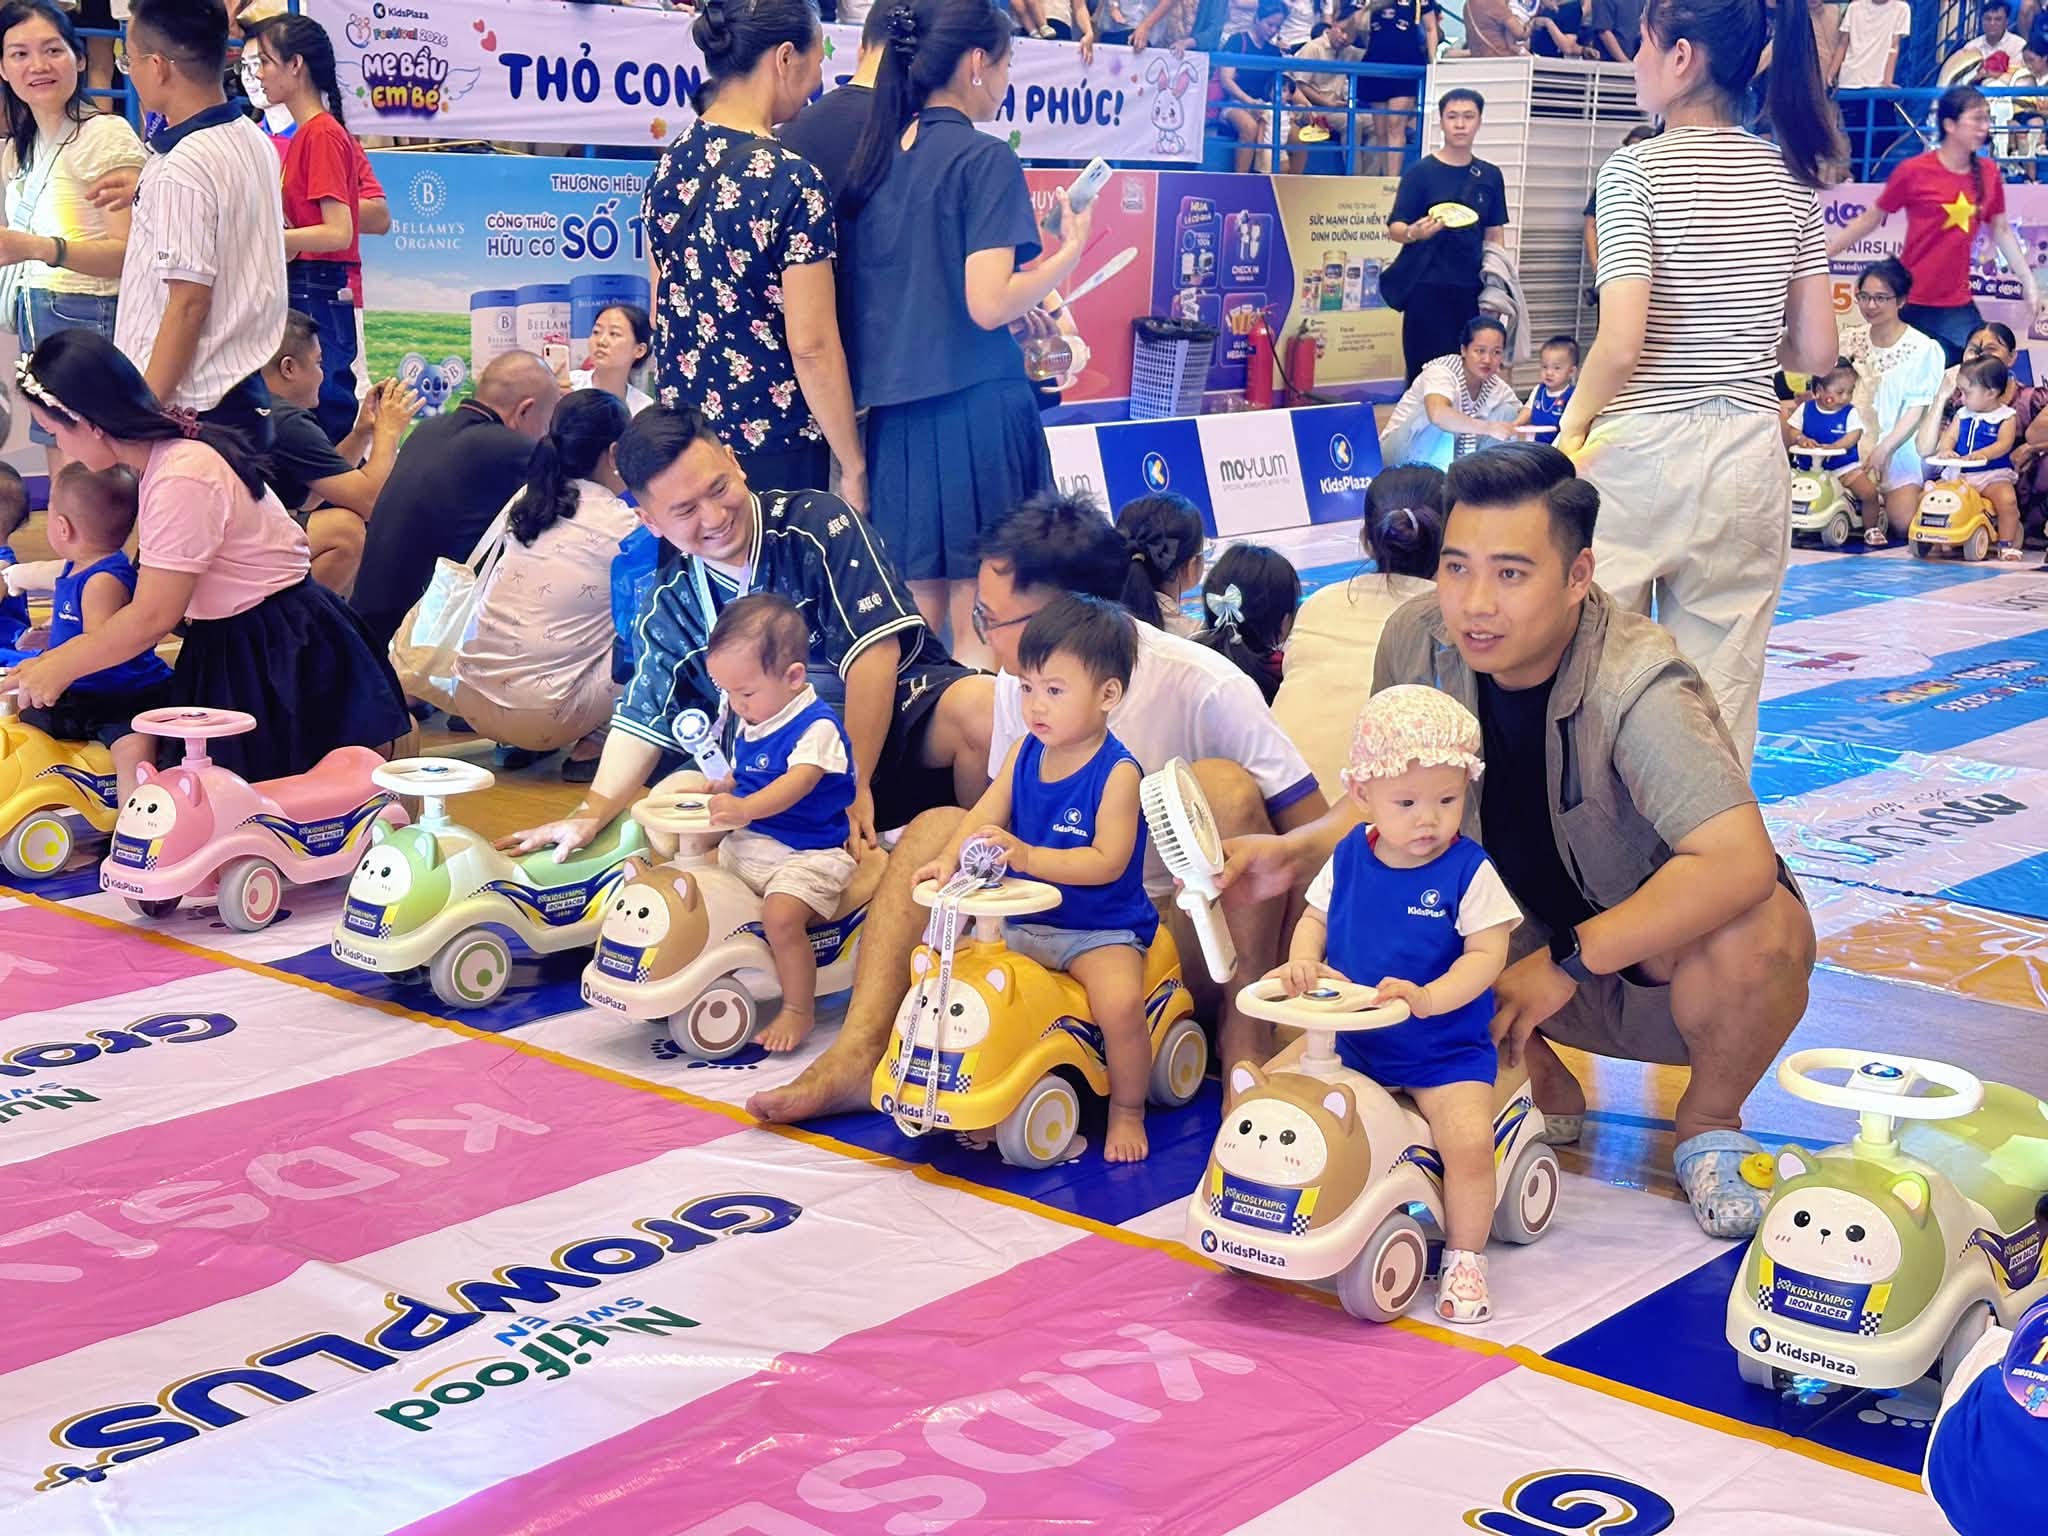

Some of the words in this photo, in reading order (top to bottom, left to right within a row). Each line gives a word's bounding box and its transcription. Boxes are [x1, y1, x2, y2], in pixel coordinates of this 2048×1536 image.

[388, 8, 429, 19] KidsPlaza
[420, 29, 448, 47] 2026
[498, 42, 602, 103] THỎ
[613, 62, 700, 107] CON
[1024, 77, 1125, 127] PHÚC!
[551, 174, 609, 192] THƯƠNG
[613, 174, 642, 195] HIỆU
[487, 213, 523, 229] CÔNG
[526, 213, 556, 229] THỨC
[561, 199, 619, 260] SỐ
[395, 236, 462, 249] ORGANIC
[488, 234, 523, 257] HỮU
[529, 236, 556, 256] CƠ
[1052, 823, 1088, 837] KidsPlaza
[111, 880, 144, 894] KidsPlaza
[343, 947, 377, 966] KidsPlaza
[592, 992, 627, 1012] KidsPlaza
[1233, 1203, 1253, 1216] IRON
[1254, 1207, 1282, 1221] RACER
[1234, 1193, 1287, 1211] KIDSLYMPIC
[1221, 1239, 1286, 1267] KidsPlaza
[1790, 1284, 1855, 1308] KIDSLYMPIC
[1788, 1296, 1813, 1311] IRON
[1814, 1304, 1848, 1320] RACER
[1776, 1340, 1857, 1376] KidsPlaza
